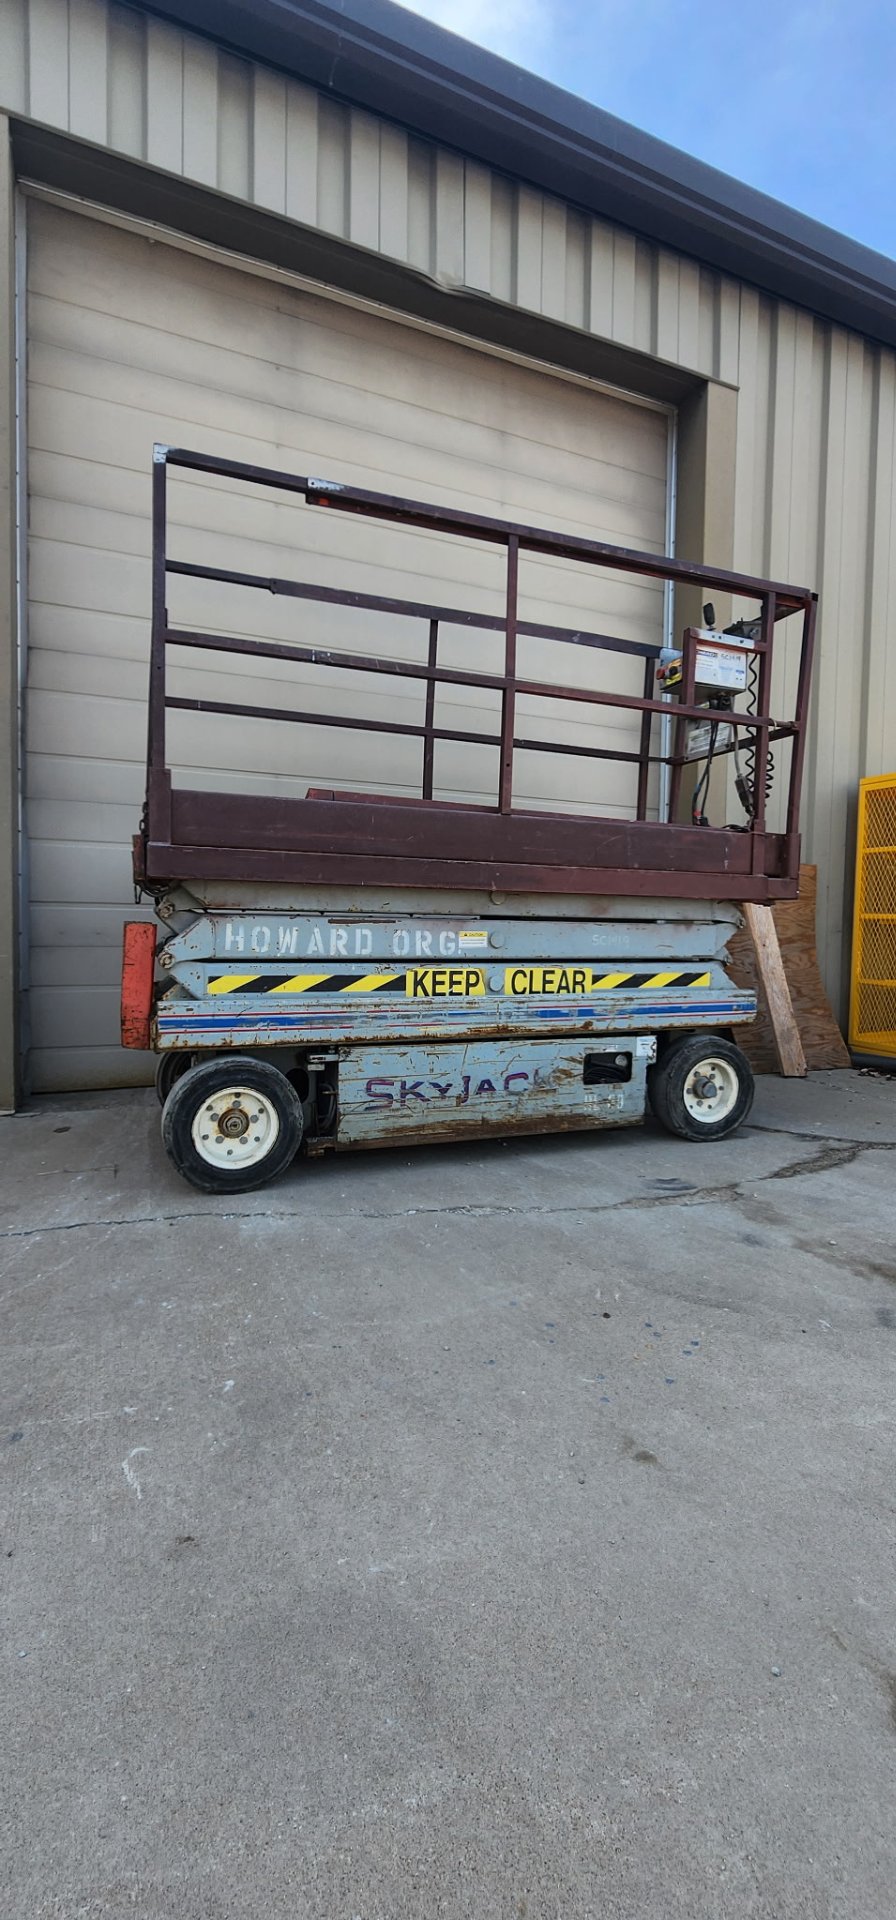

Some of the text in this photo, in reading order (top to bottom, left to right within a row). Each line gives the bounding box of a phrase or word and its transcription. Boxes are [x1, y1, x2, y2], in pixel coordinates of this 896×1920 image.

[224, 923, 373, 955] HOWARD
[413, 969, 586, 997] KEEP CLEAR
